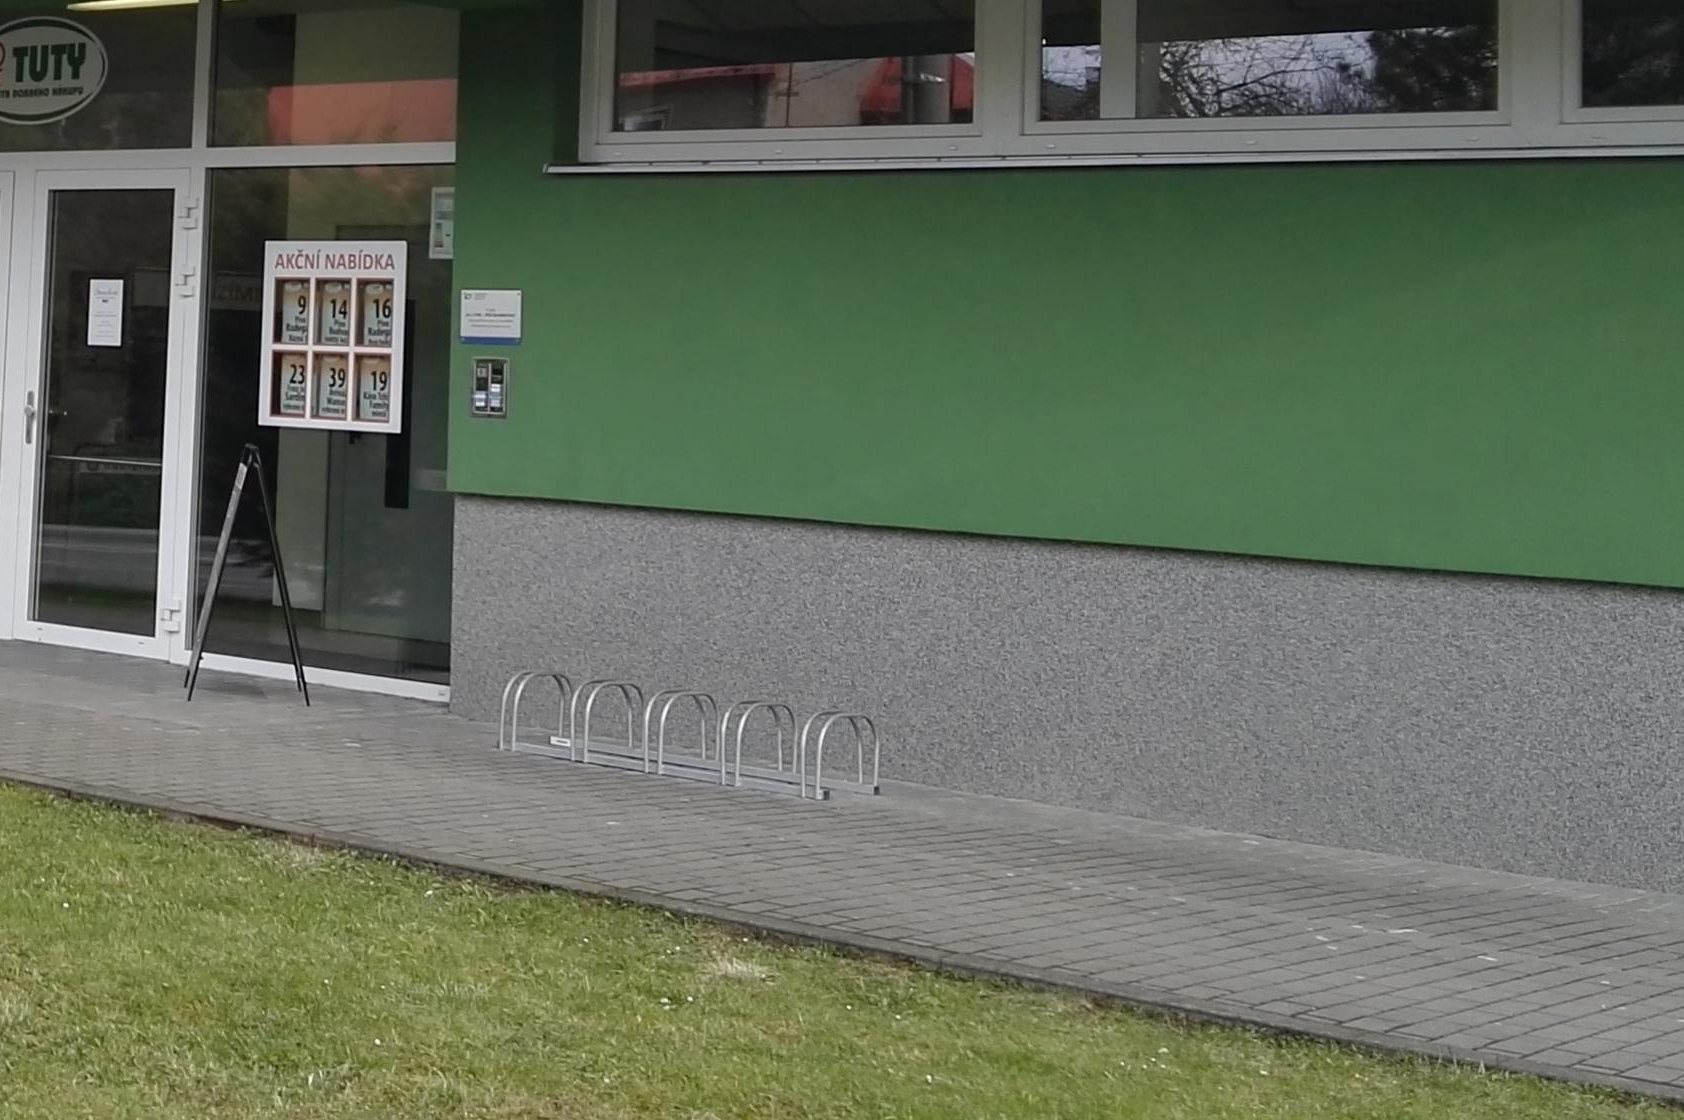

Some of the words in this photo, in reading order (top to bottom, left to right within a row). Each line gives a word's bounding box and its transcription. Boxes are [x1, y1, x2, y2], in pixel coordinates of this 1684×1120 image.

[13, 43, 86, 83] TUTY
[275, 249, 321, 270] AKČNÍ
[325, 250, 396, 270] NABÍDKA
[297, 295, 307, 315] 9
[330, 298, 348, 319] 14
[372, 298, 392, 319] 16
[289, 364, 305, 384] 23
[328, 367, 346, 388] 39
[371, 371, 388, 391] 19
